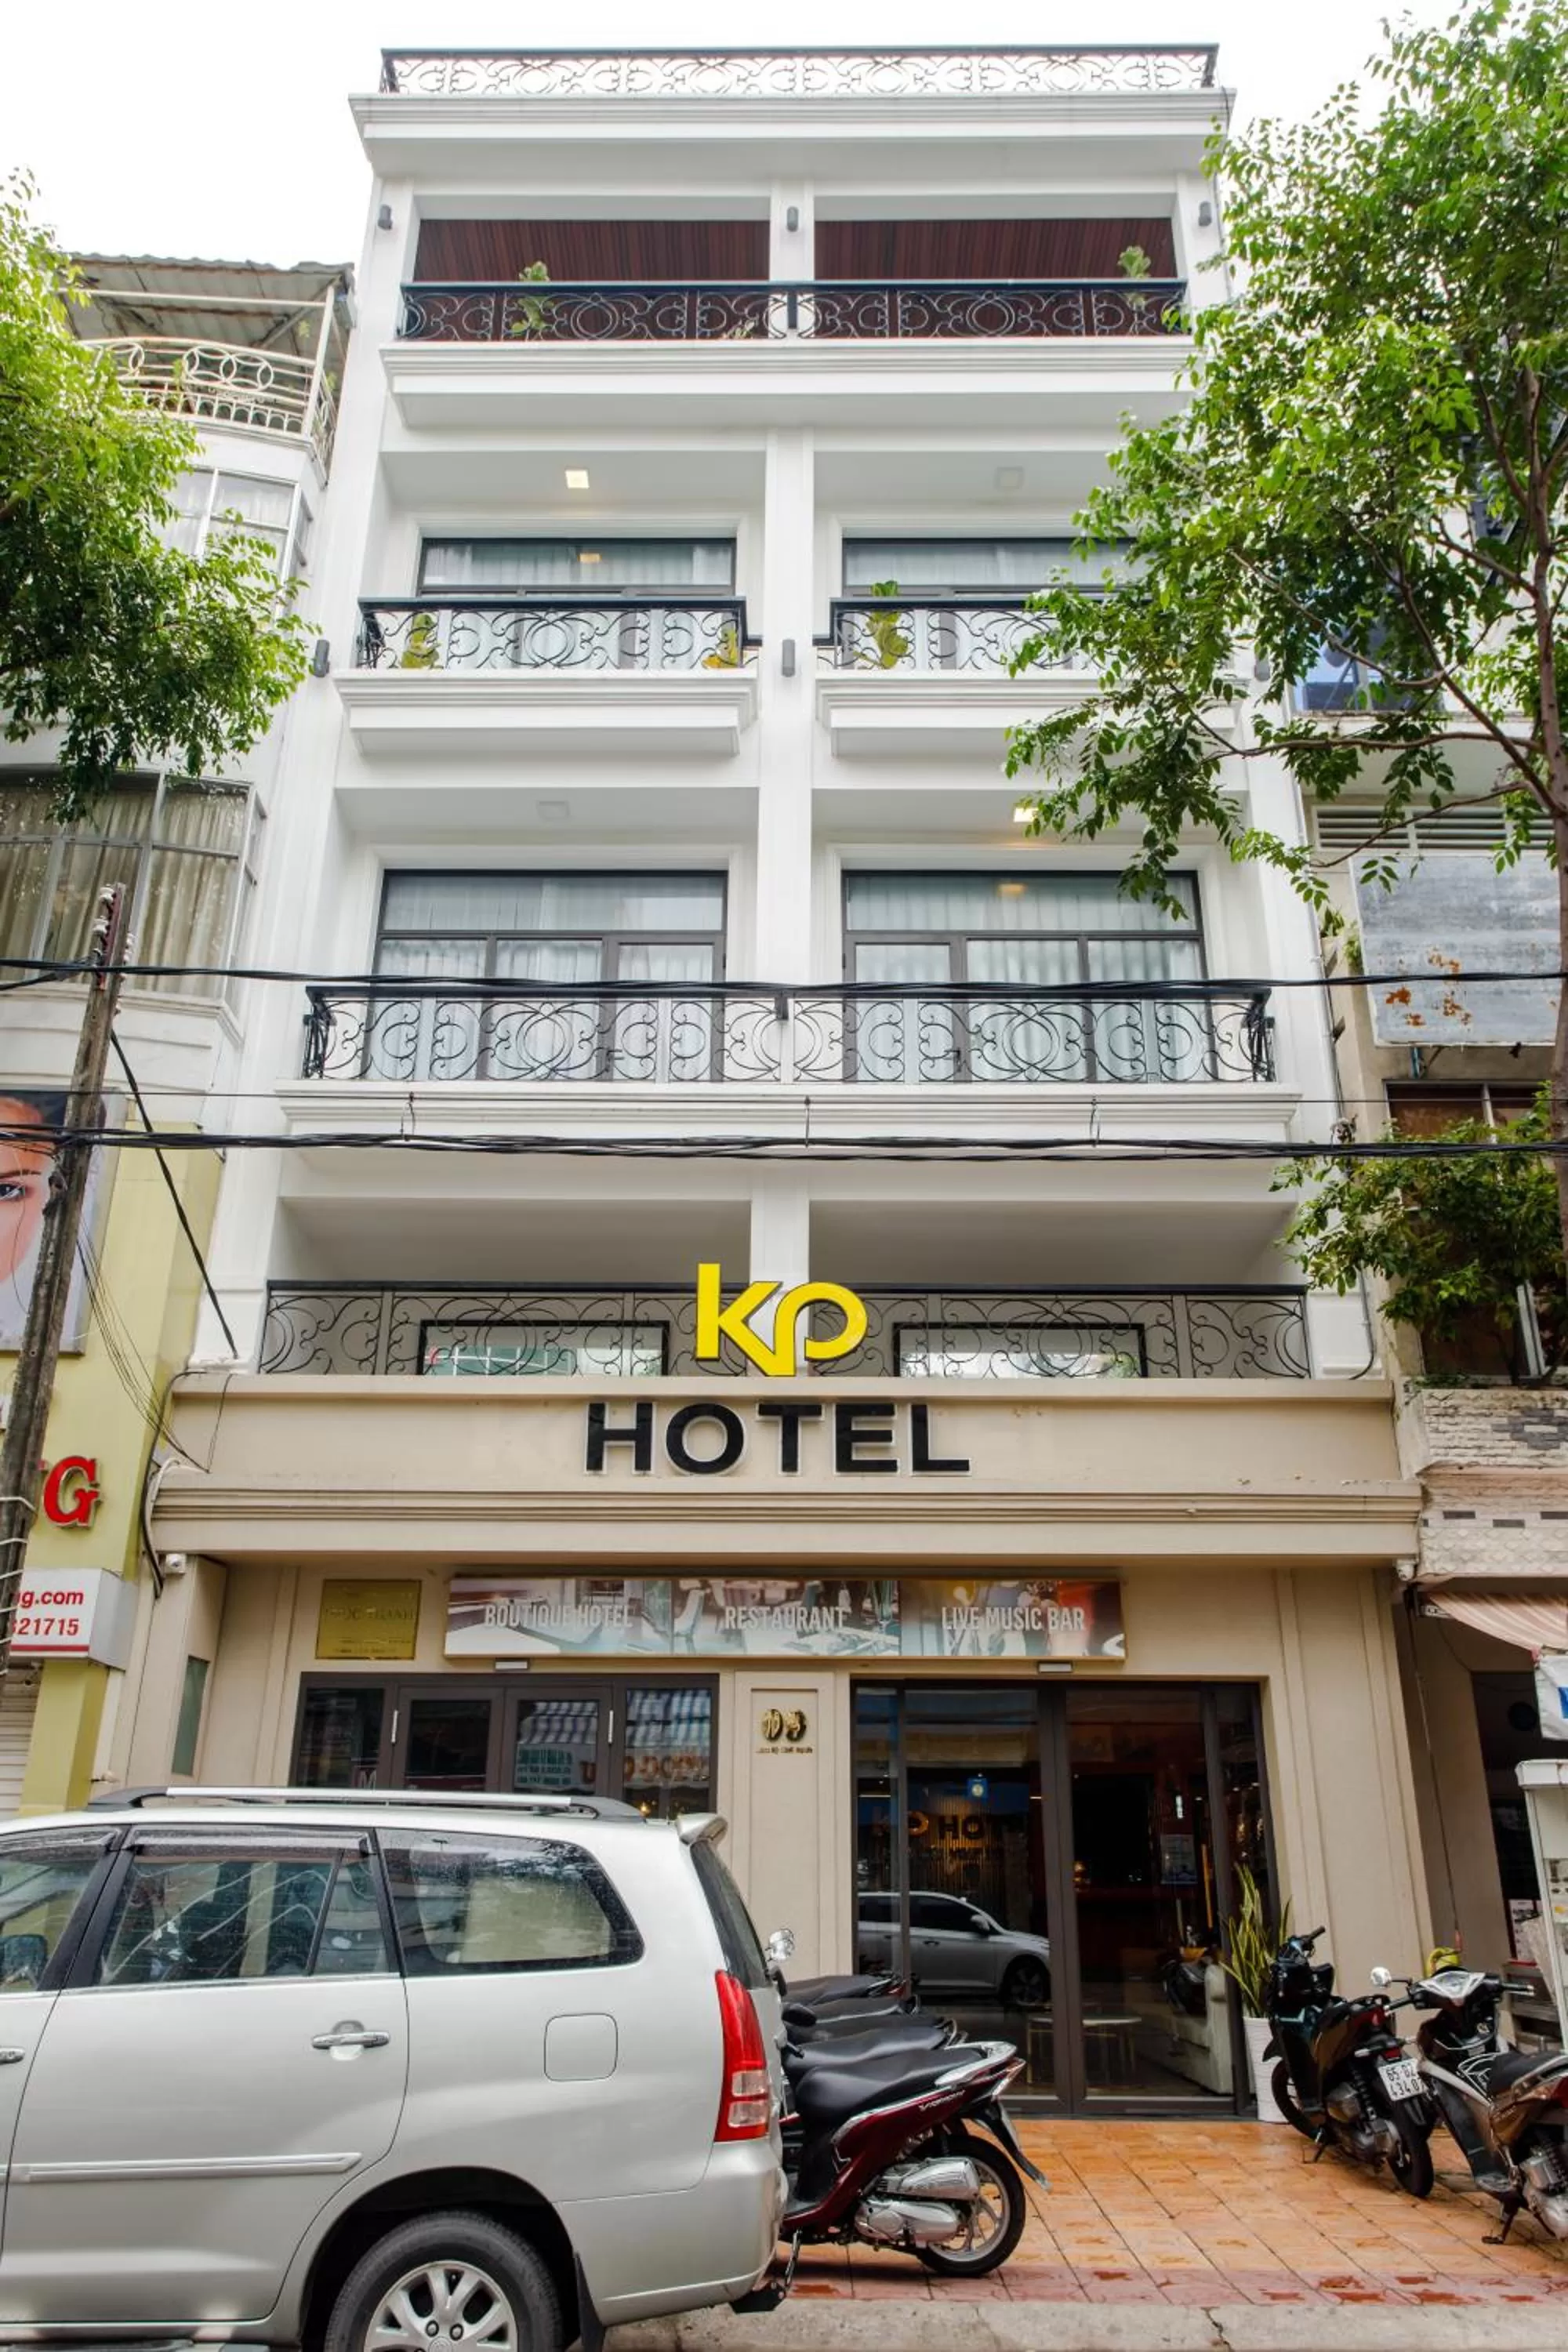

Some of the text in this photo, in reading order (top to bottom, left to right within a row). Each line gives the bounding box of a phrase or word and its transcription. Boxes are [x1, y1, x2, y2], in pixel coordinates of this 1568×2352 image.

[585, 1402, 971, 1475] HOTEL
[39, 1455, 99, 1526] G
[17, 1590, 85, 1609] g.com
[485, 1605, 633, 1628] BOUTIQUE HOTEL
[724, 1606, 850, 1632] RESTAURANT
[942, 1606, 1085, 1631] LIVE MUSIC BAR
